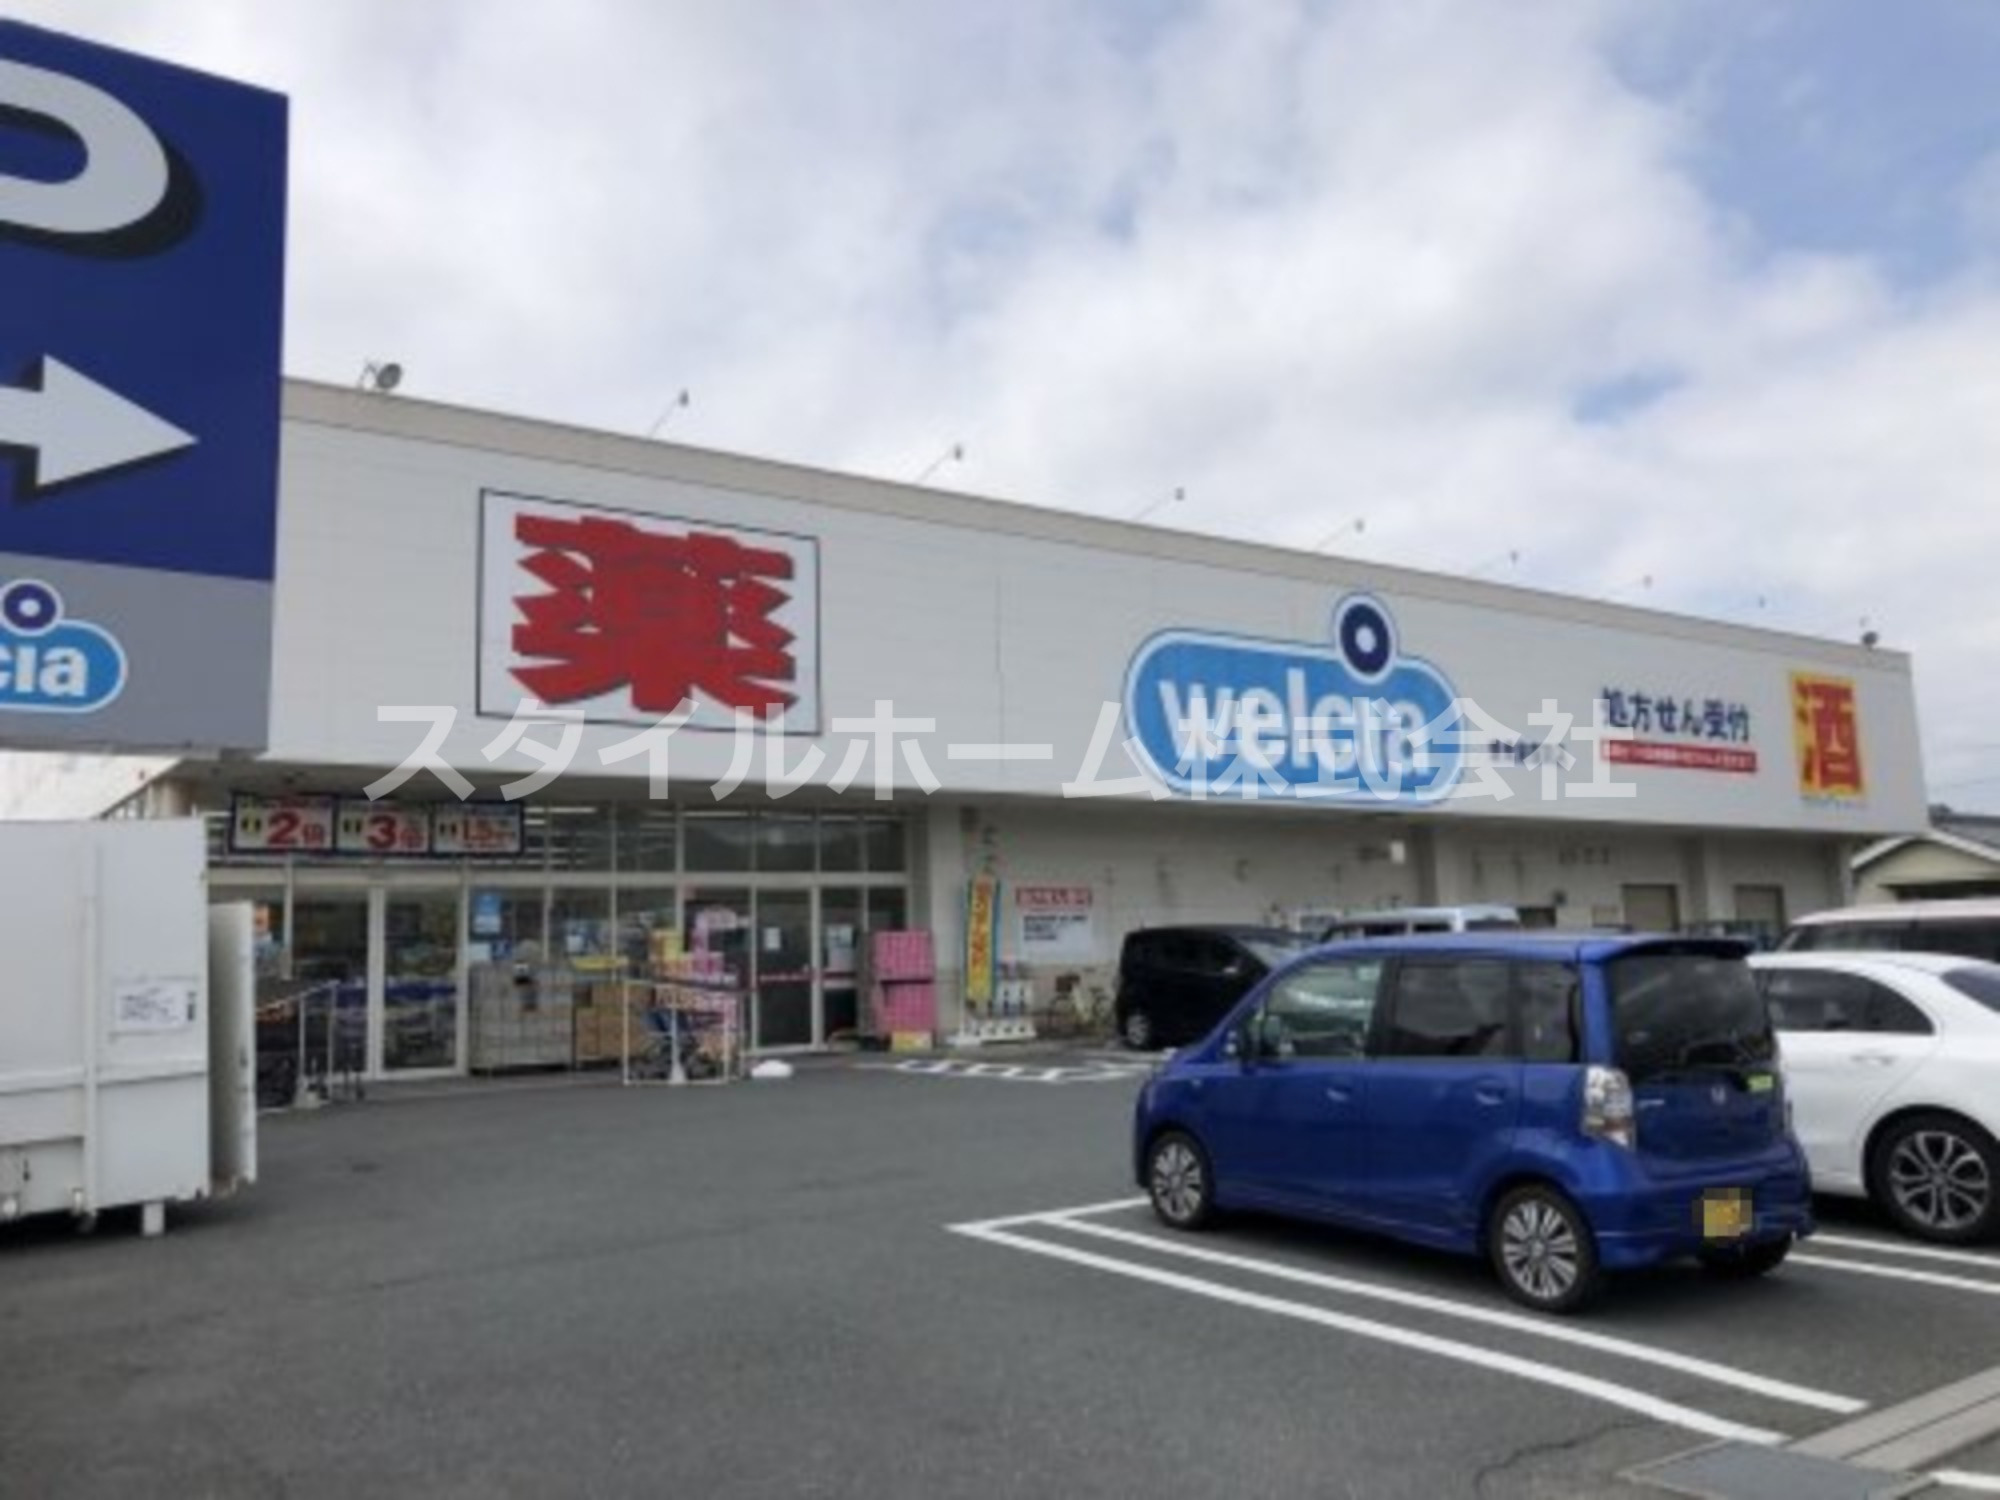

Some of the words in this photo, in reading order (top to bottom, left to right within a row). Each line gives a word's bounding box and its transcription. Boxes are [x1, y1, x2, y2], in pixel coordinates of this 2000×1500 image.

[508, 511, 797, 720] 薬
[1158, 668, 1431, 777] welcia
[1602, 687, 1749, 743] 処方せん受付
[1794, 681, 1862, 790] 酒
